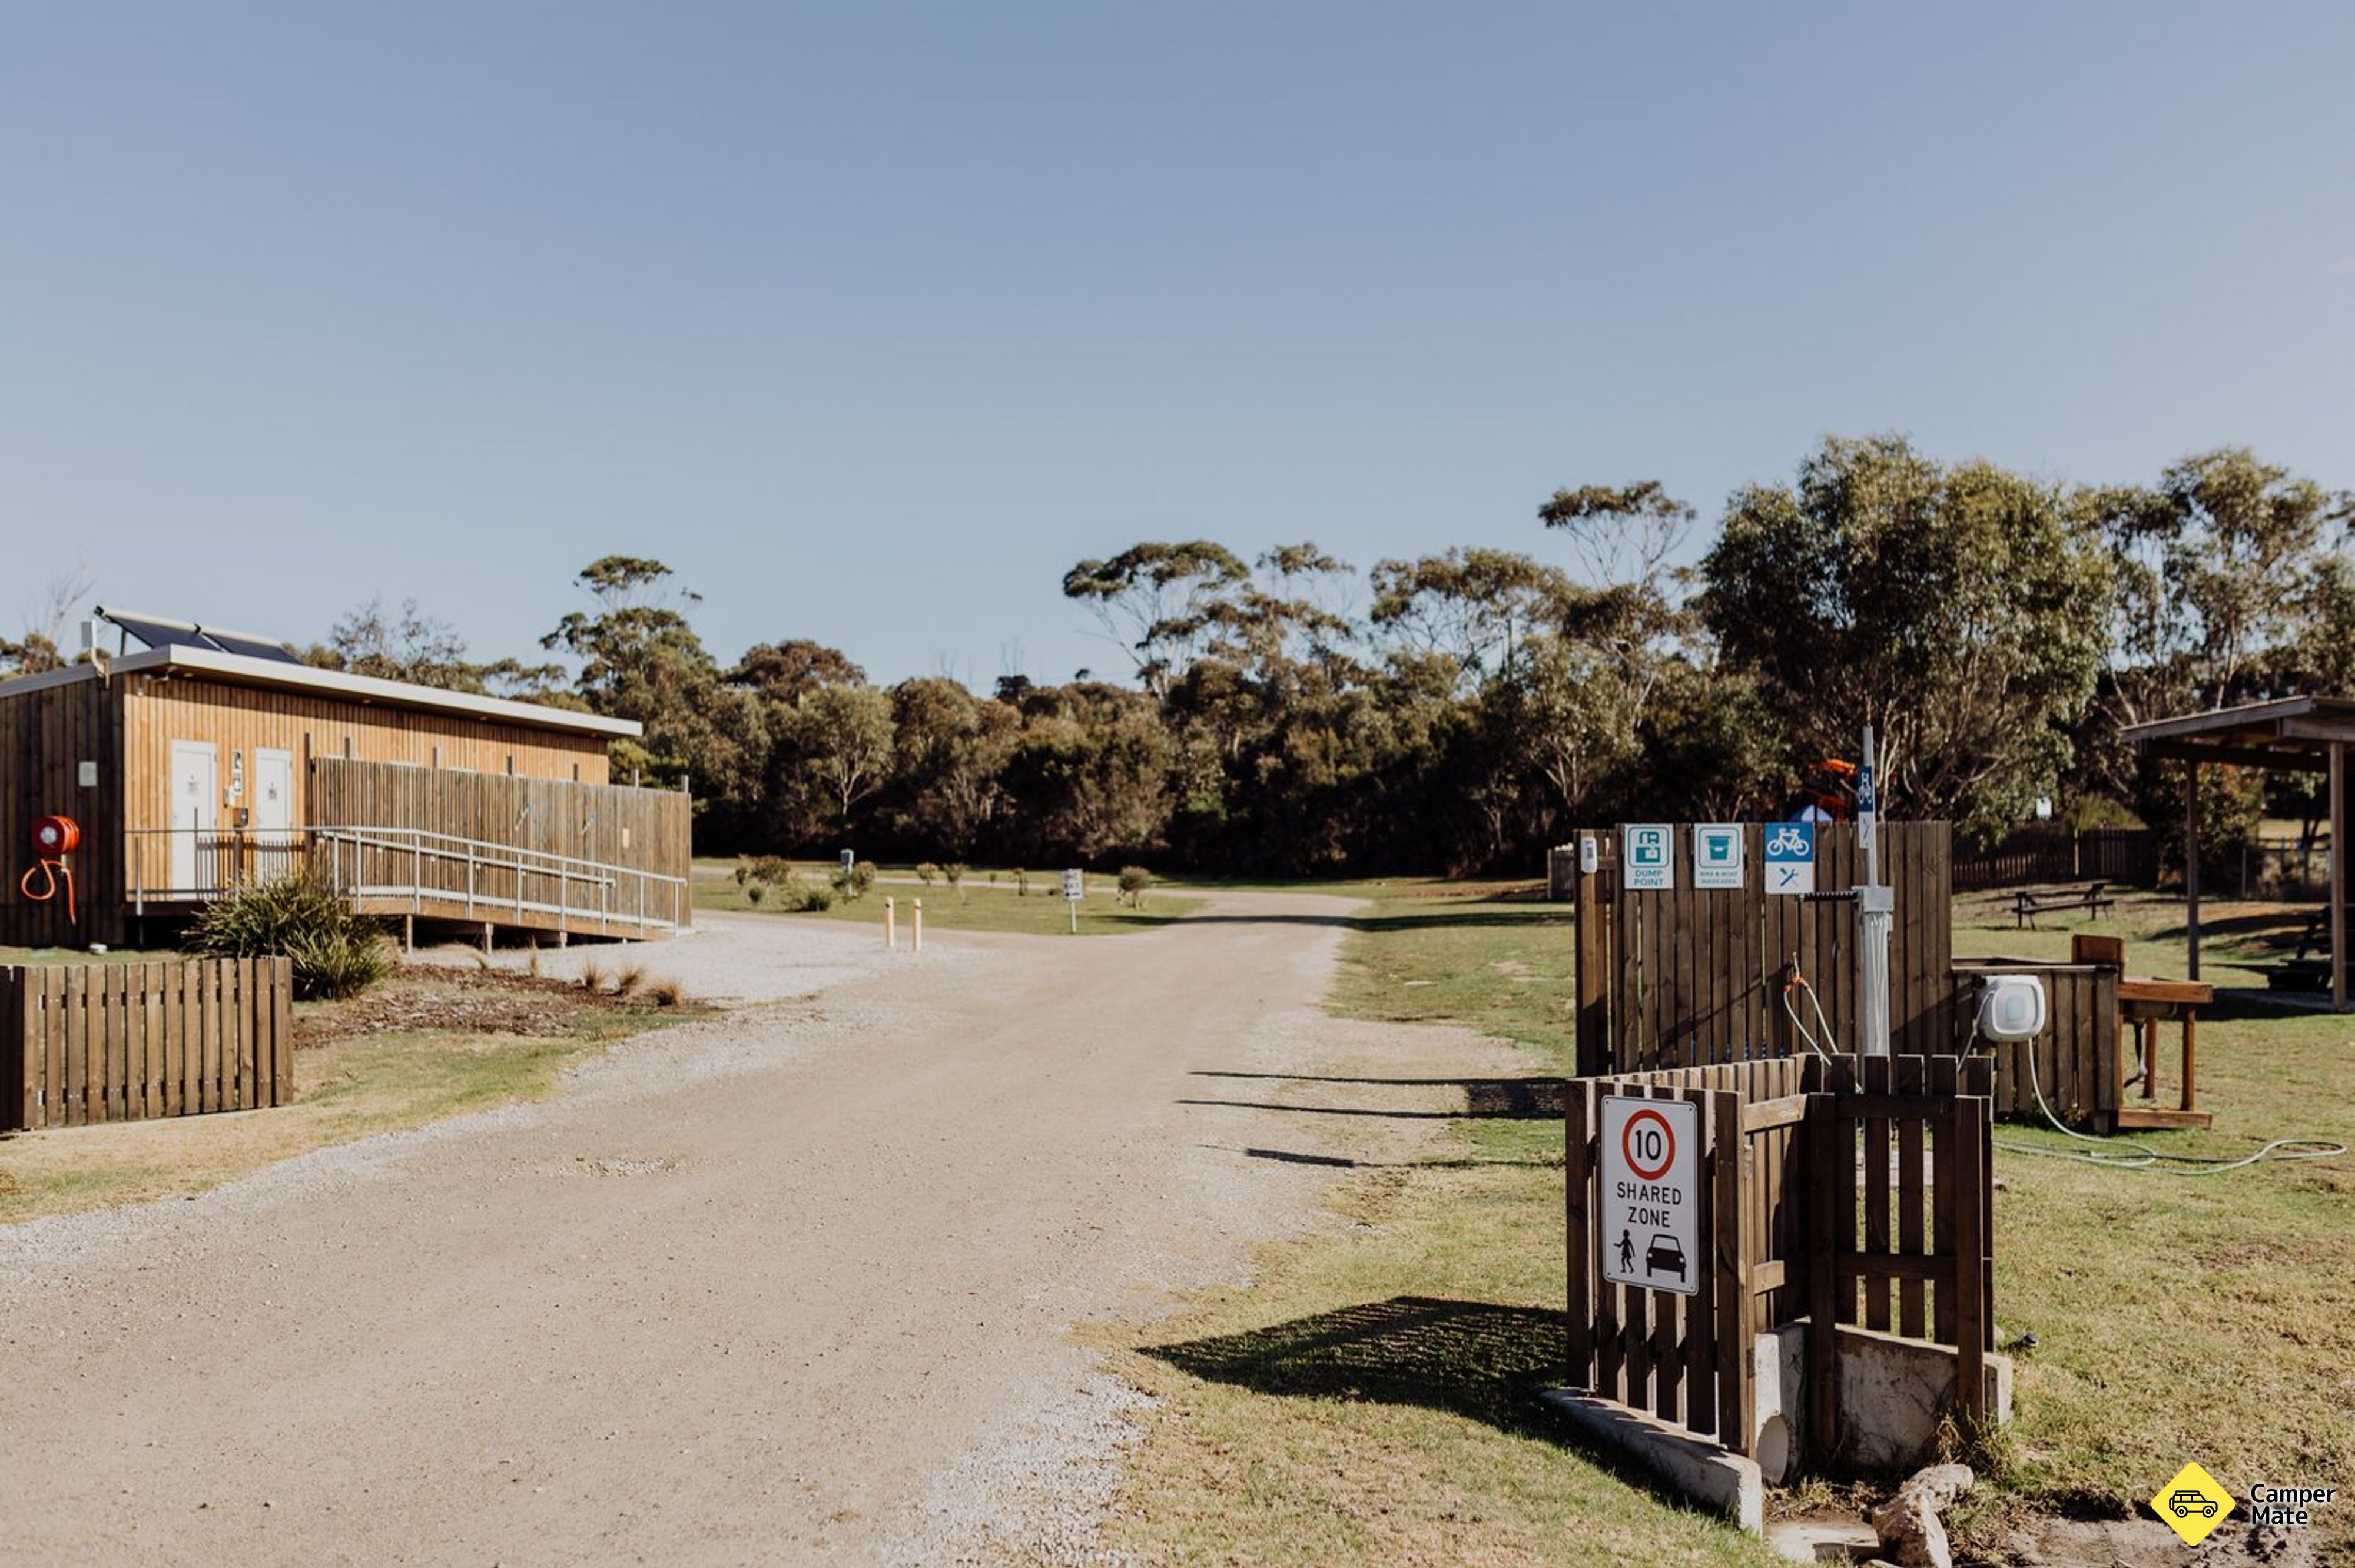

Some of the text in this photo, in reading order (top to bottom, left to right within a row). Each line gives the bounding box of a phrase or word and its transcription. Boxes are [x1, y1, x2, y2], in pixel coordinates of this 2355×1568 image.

[1636, 1130, 1662, 1160] 10
[1617, 1181, 1682, 1205] SHARED
[1628, 1206, 1670, 1227] ZONE
